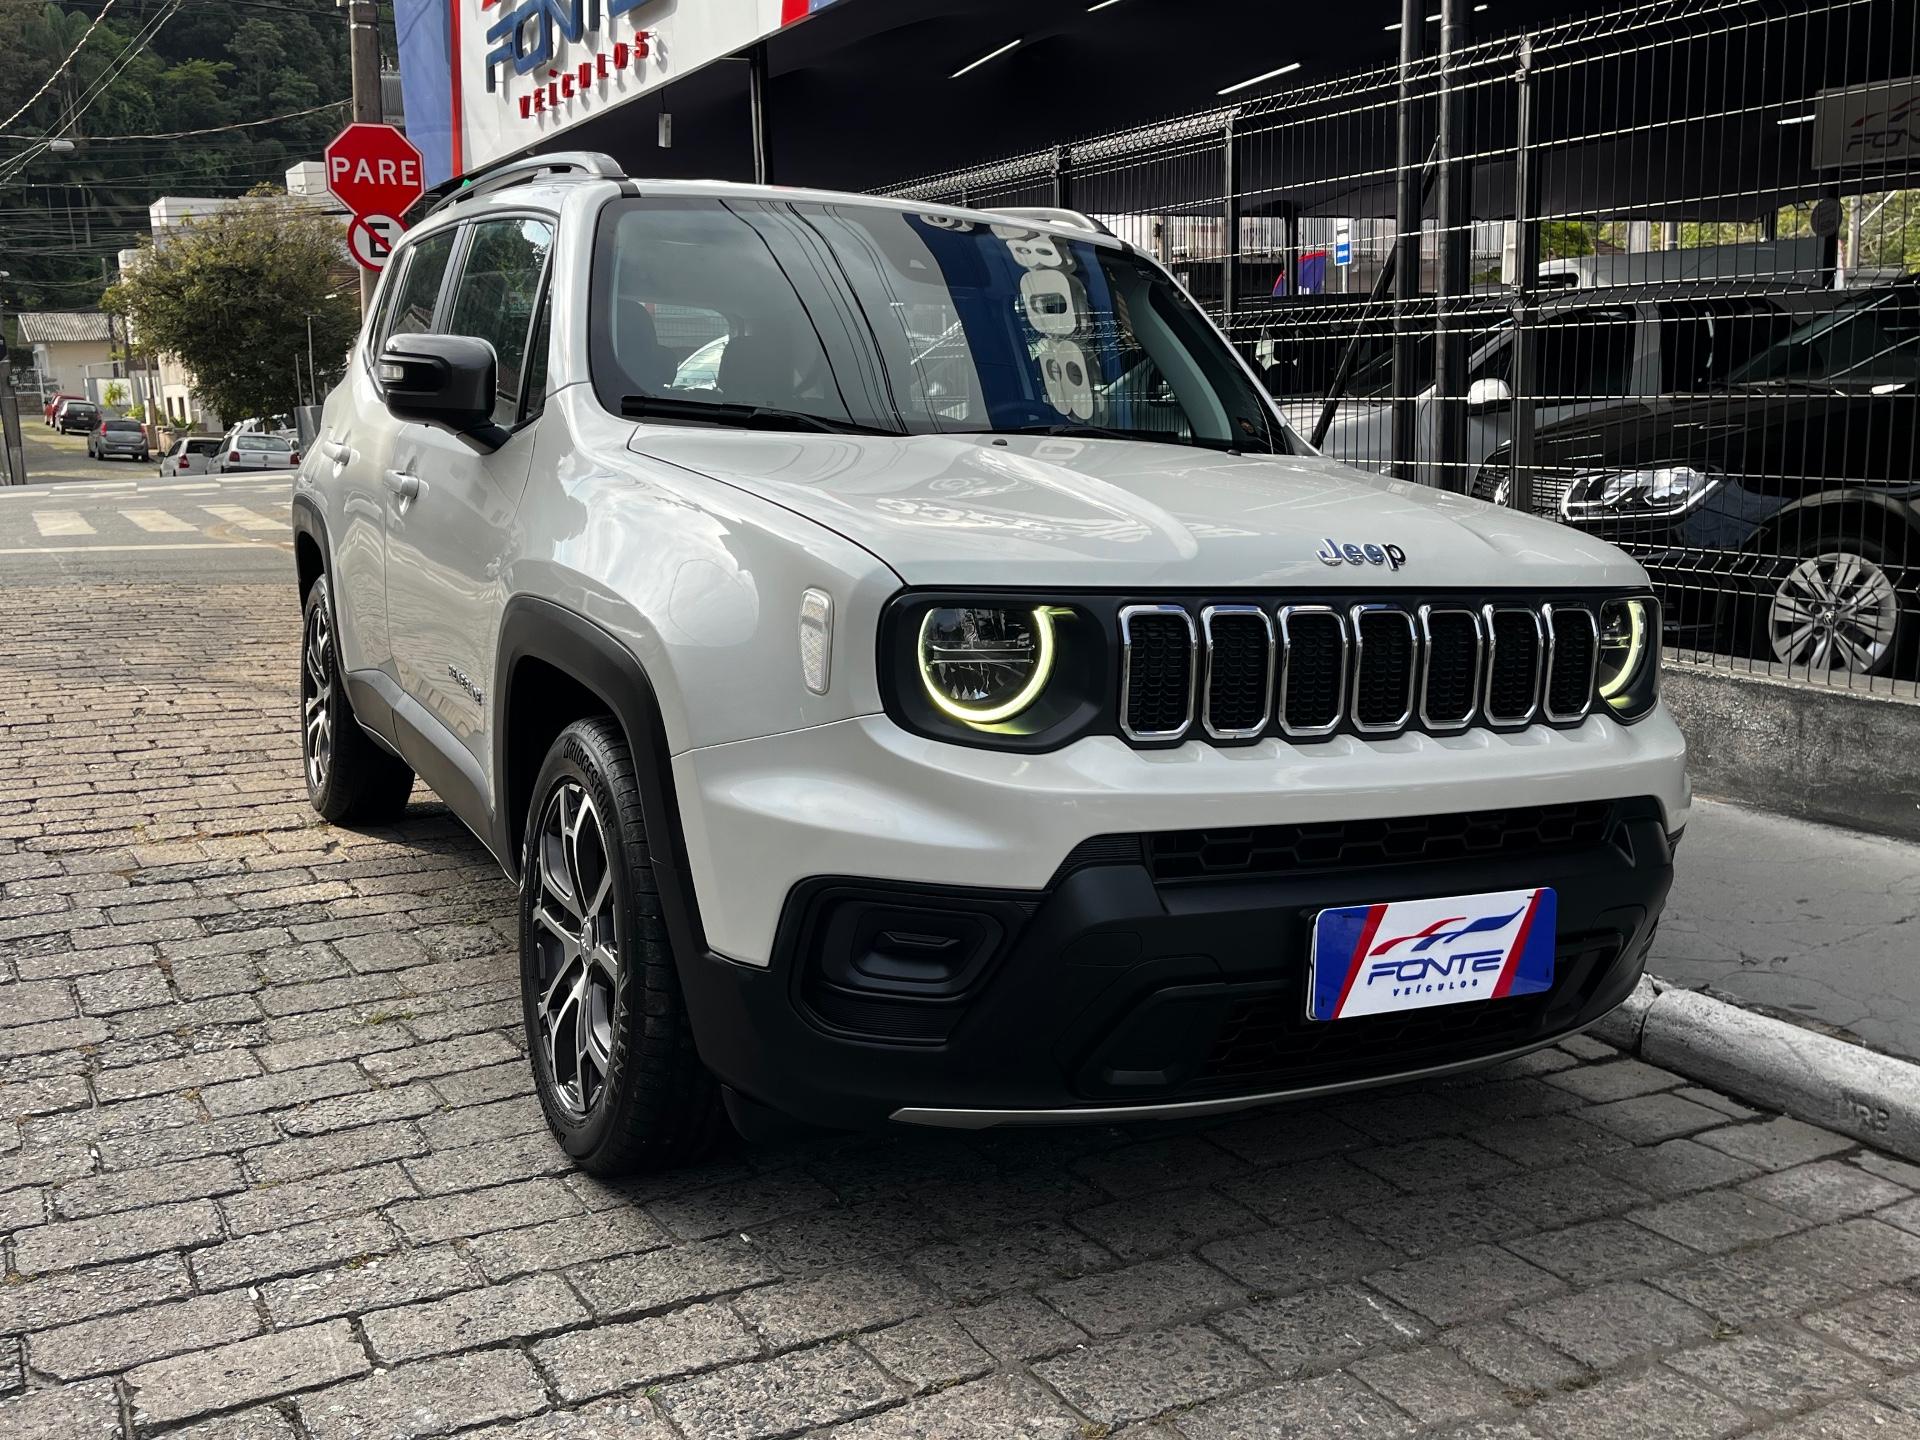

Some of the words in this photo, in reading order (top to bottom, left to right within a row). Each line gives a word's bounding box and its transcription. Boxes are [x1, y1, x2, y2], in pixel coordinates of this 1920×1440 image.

[331, 156, 419, 186] PARE
[367, 222, 391, 258] E
[1315, 538, 1407, 572] Jeep
[1367, 950, 1504, 985] FONTE
[1393, 978, 1479, 997] VEÍCULOS
